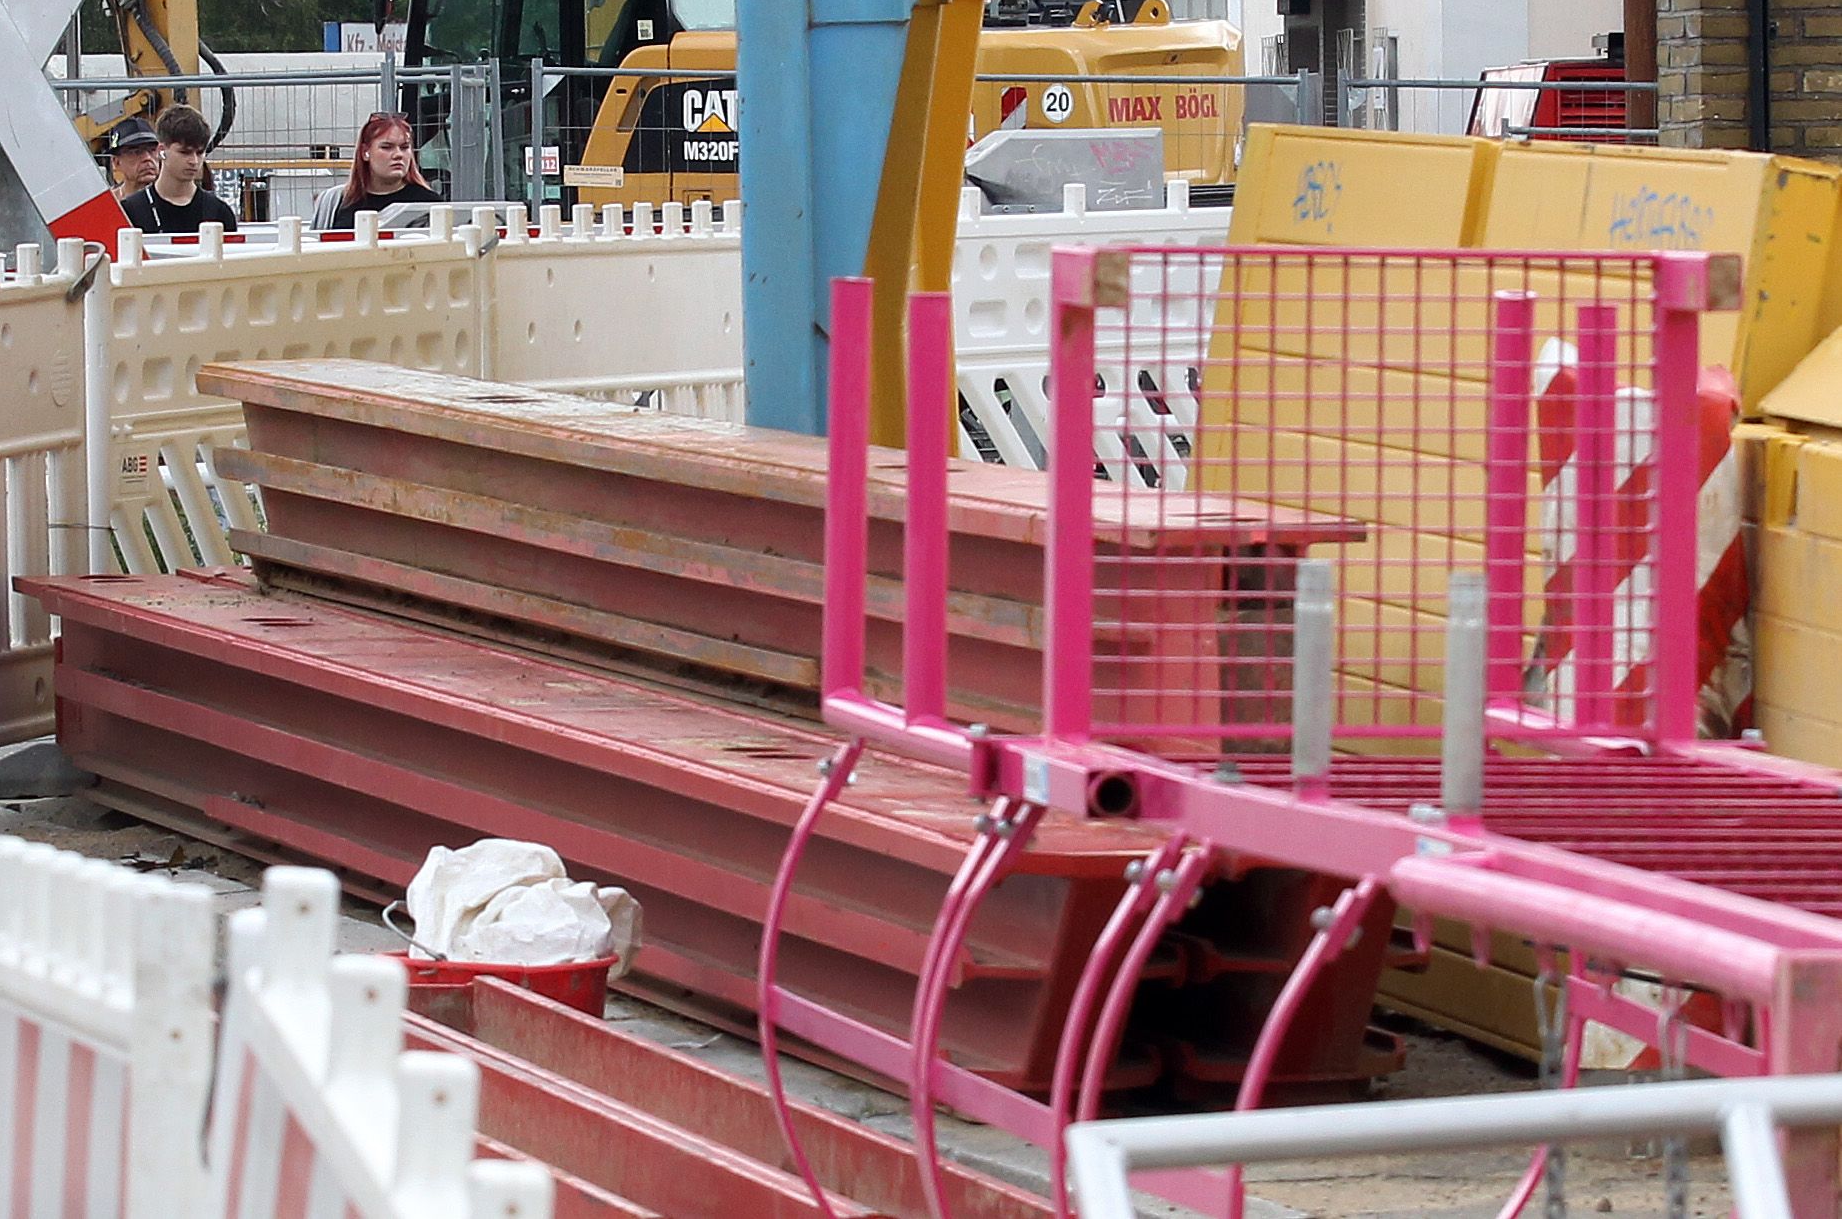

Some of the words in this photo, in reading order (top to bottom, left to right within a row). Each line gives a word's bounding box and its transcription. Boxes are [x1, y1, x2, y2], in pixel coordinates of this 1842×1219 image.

[683, 89, 738, 132] CAT
[1046, 92, 1069, 112] 20
[1108, 96, 1162, 123] MAX
[1176, 88, 1220, 119] BÖGL
[683, 141, 739, 161] M320F
[121, 455, 139, 474] ABG
